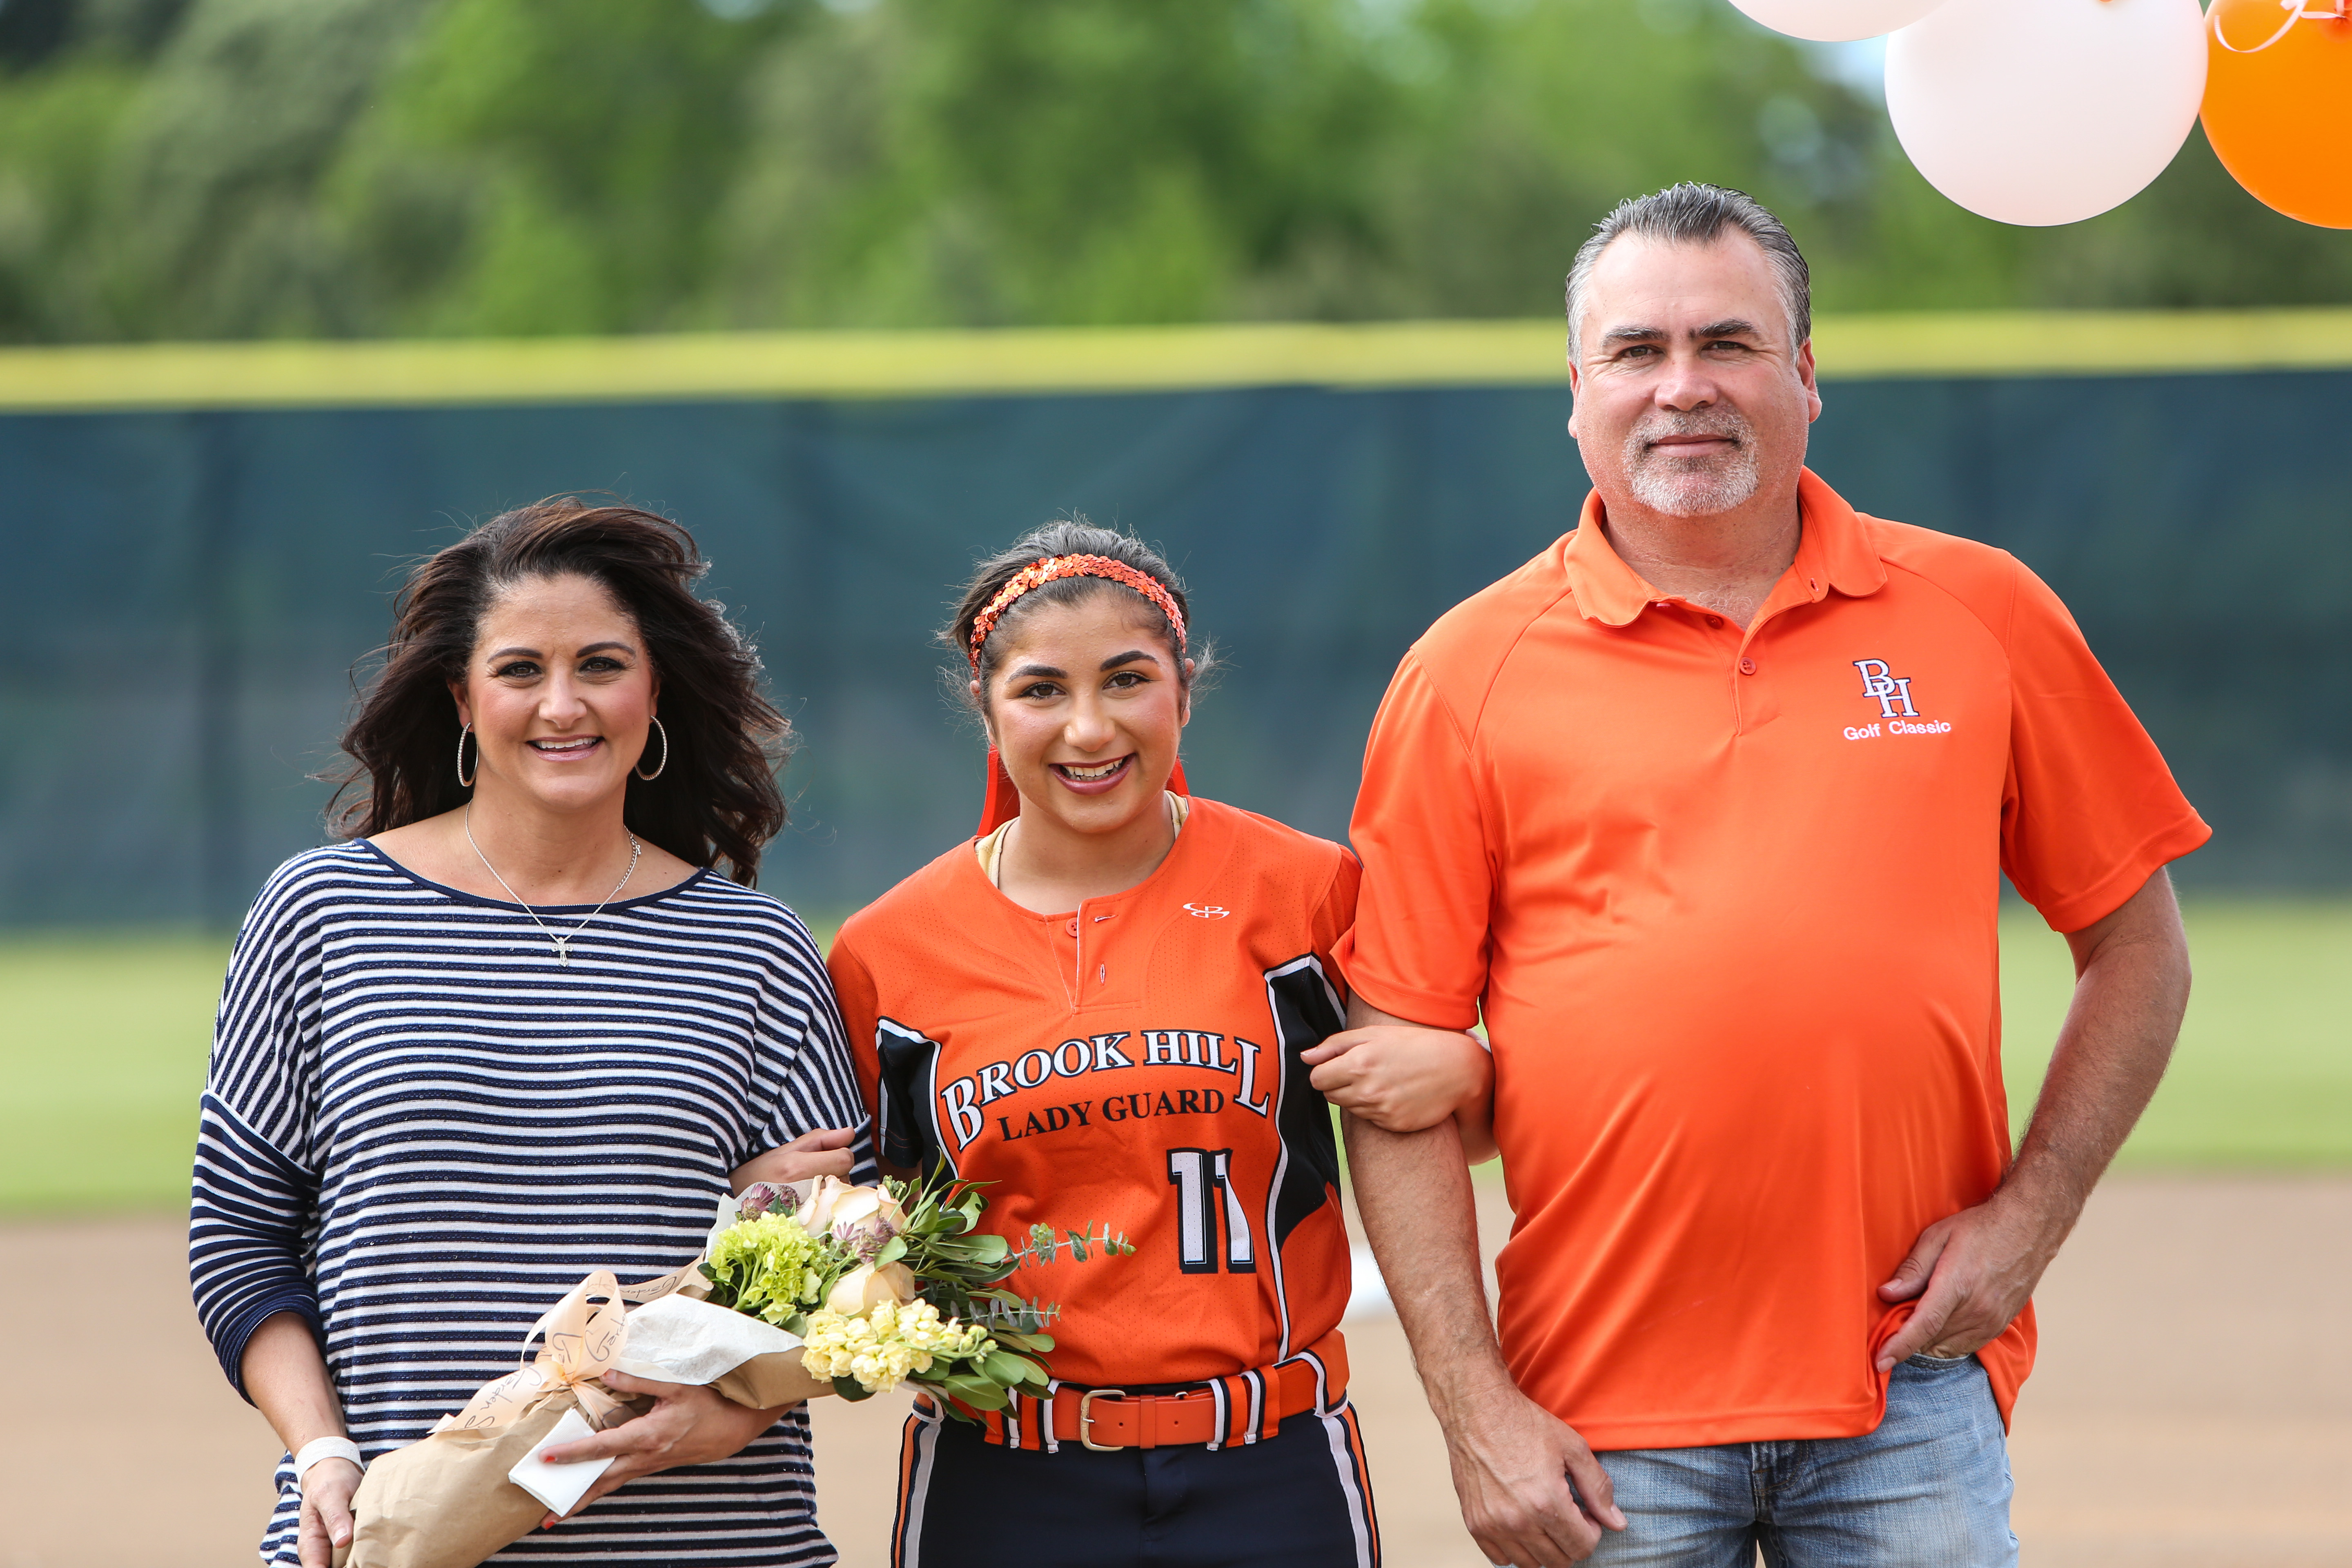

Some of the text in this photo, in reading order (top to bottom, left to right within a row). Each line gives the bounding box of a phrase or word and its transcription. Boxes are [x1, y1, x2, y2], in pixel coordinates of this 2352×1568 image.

[1843, 720, 1951, 740] Golf Classic
[940, 1029, 1270, 1152] BROOK HILL
[997, 1089, 1225, 1142] LADY GUARD
[1167, 1148, 1256, 1274] 11
